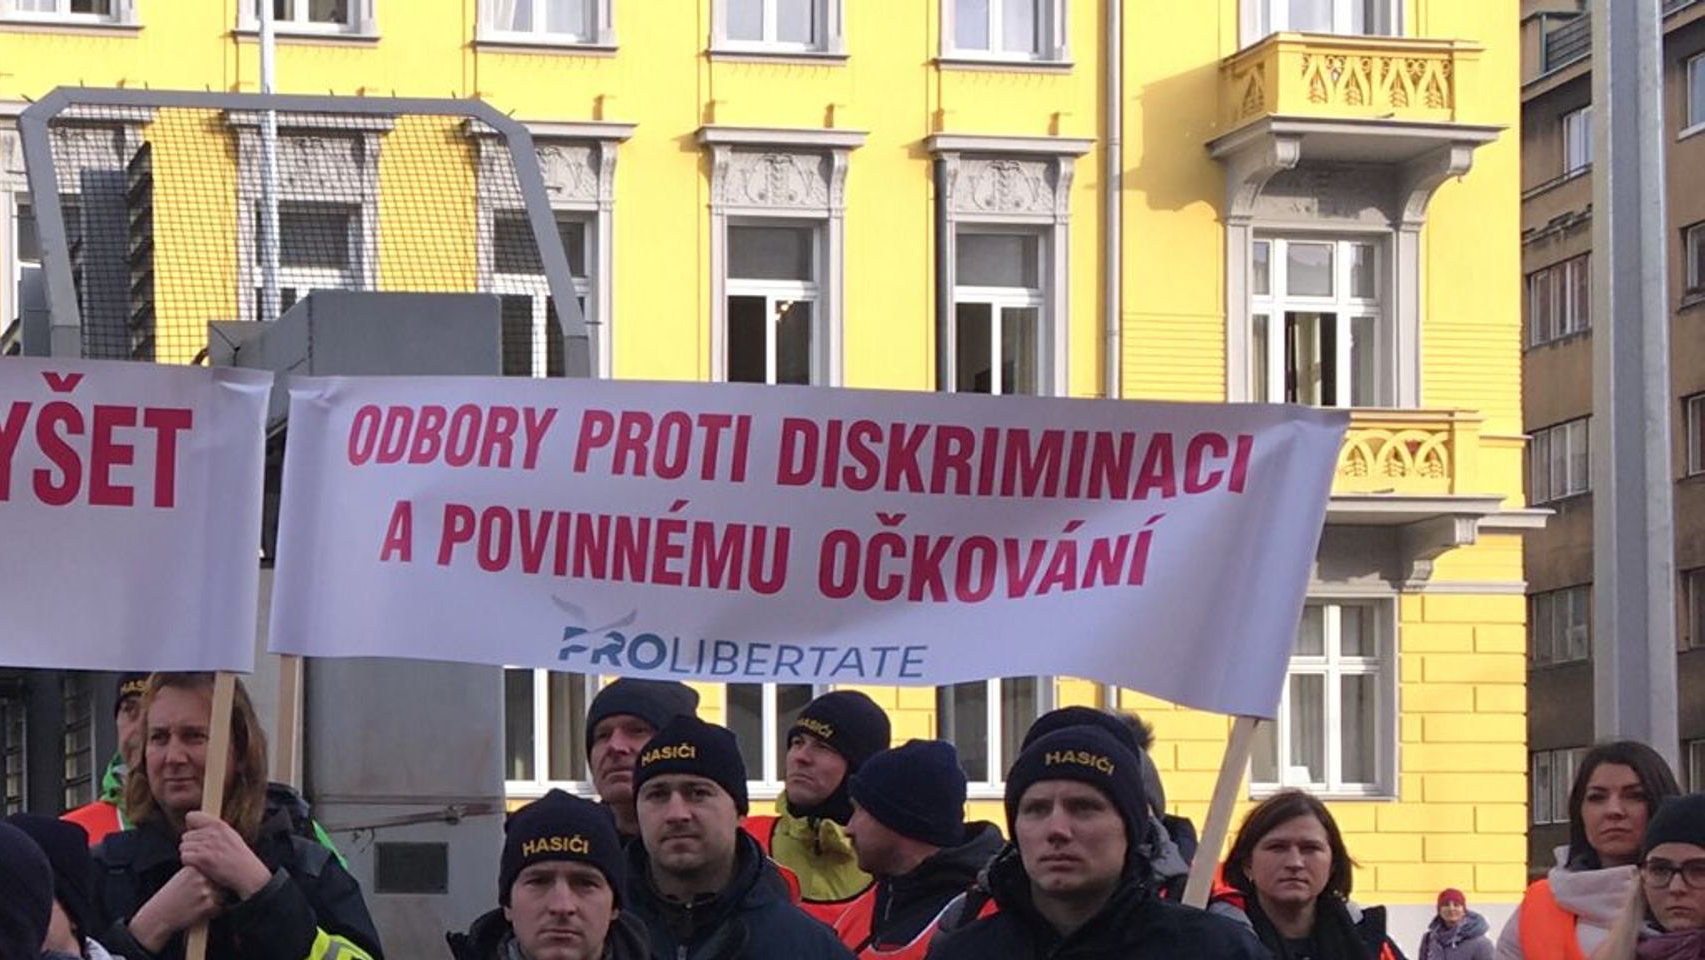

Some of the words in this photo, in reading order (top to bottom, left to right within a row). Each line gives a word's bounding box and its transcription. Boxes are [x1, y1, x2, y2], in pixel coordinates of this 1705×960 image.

[348, 404, 558, 470] ODBORY
[573, 410, 752, 482] PROTI
[776, 418, 1254, 500] DISKRIMINACI
[380, 500, 414, 563] A
[437, 499, 792, 595] POVINNÉMU
[818, 512, 1167, 603] OČKOVÁNÍ
[557, 625, 929, 679] PROLIBERTATE
[640, 742, 696, 768] HASIČI
[1044, 749, 1115, 775] HASIČI
[521, 833, 589, 857] HASIČI
